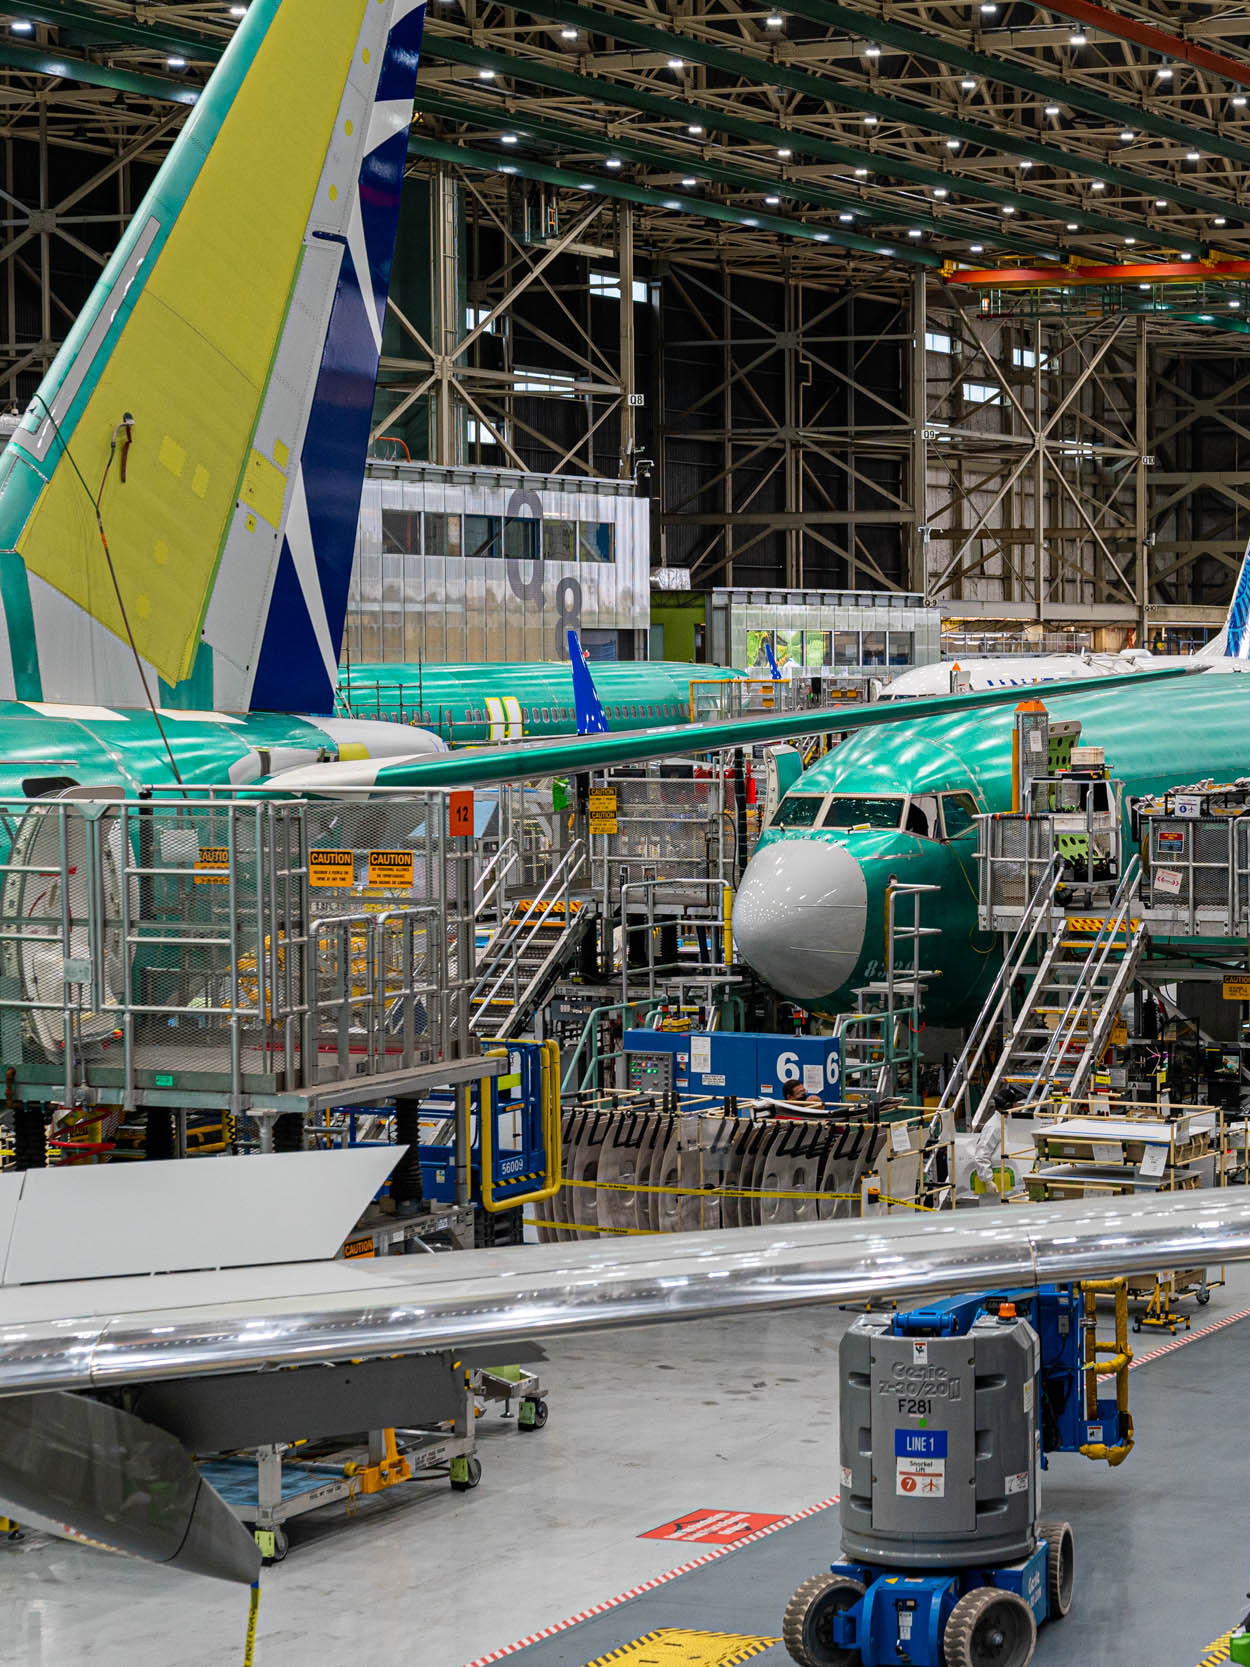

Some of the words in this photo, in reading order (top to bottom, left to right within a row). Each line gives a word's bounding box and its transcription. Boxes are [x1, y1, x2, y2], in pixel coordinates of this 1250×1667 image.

[591, 787, 615, 796] CAUTION
[456, 805, 469, 822] 12
[591, 811, 616, 819] CAUTION
[200, 851, 228, 861] CAUTIO
[311, 853, 351, 865] CAUTION
[371, 855, 411, 866] CAUTION
[776, 1051, 800, 1085] 6
[826, 1051, 839, 1085] 6
[501, 1158, 524, 1175] 56009
[345, 1240, 373, 1257] CAUTION
[891, 1361, 949, 1381] Genie
[898, 1399, 932, 1414] F281
[906, 1435, 927, 1452] LINE
[929, 1437, 935, 1452] 1
[909, 1460, 933, 1468] Snorkel
[905, 1479, 913, 1489] 7
